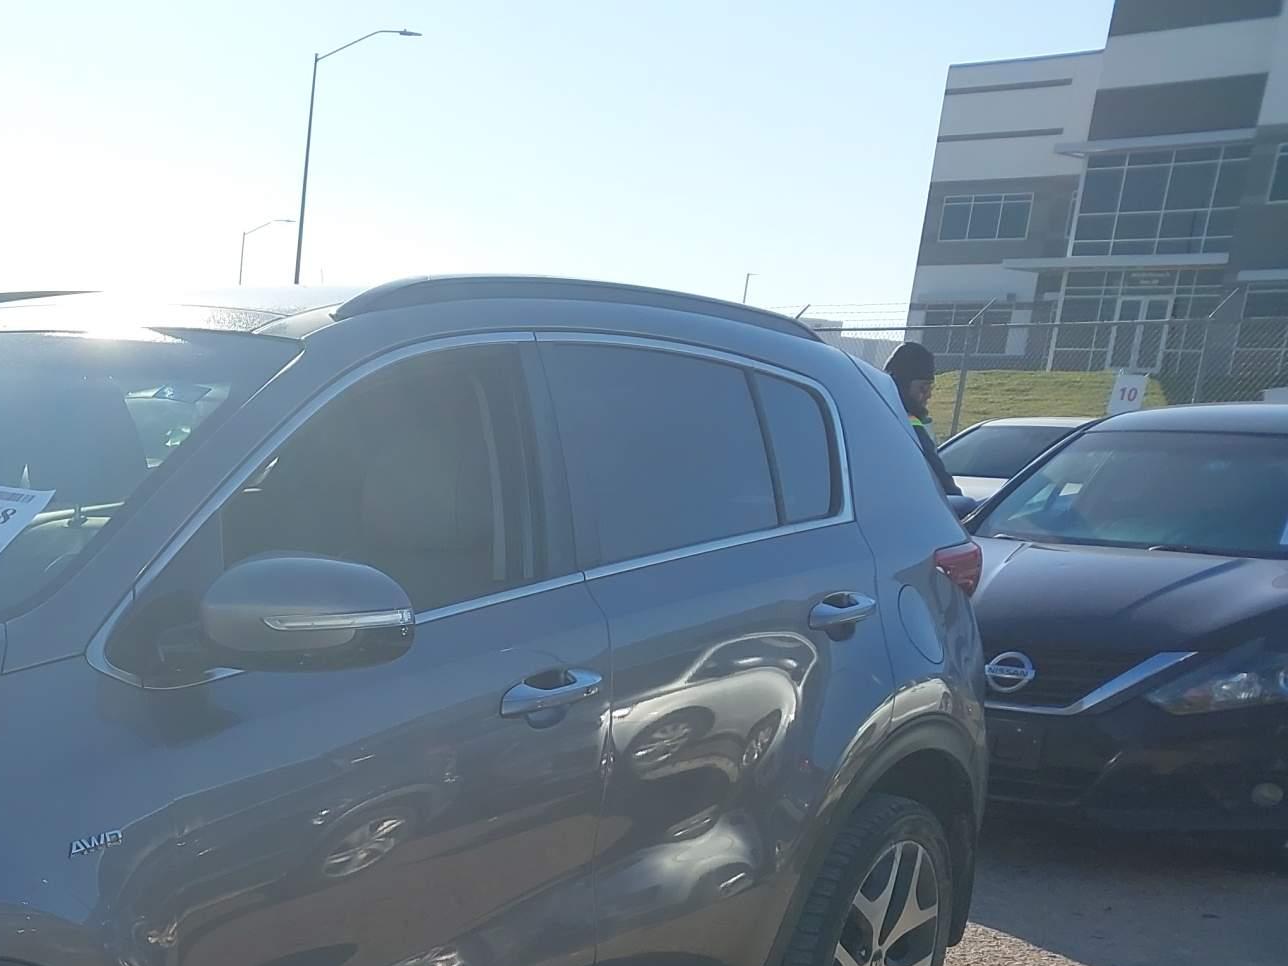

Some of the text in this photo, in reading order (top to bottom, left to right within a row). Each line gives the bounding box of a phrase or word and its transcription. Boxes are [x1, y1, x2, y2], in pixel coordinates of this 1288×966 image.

[1119, 386, 1138, 402] 10
[987, 666, 1029, 678] NISSAN
[69, 829, 123, 858] AWD
